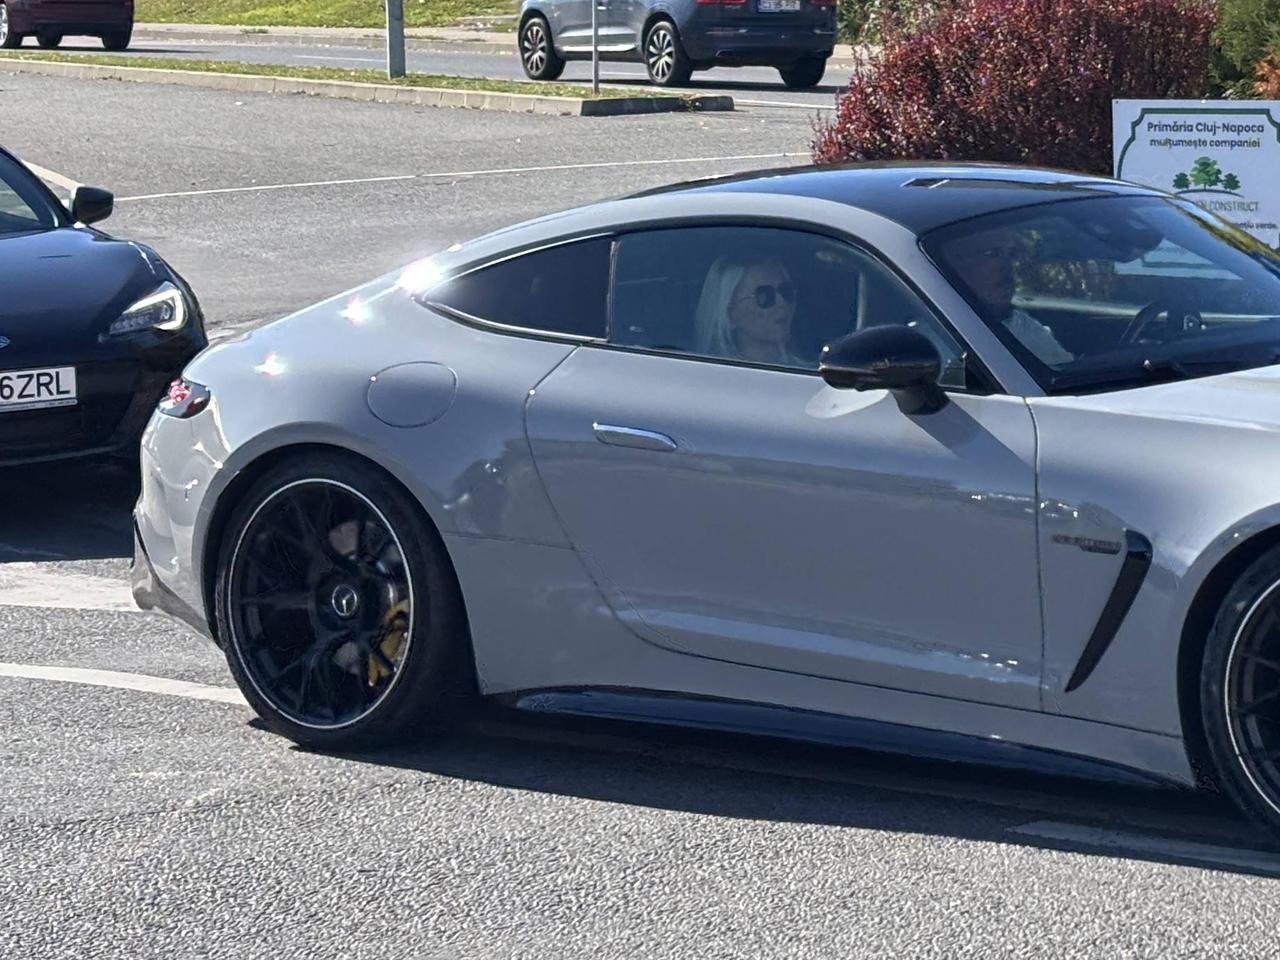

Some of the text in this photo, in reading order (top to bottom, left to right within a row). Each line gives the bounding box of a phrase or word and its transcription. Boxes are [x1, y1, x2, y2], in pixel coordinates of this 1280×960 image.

[1147, 121, 1265, 136] Primăria Cluj-Napoca
[1209, 137, 1261, 150] companiei
[1209, 201, 1260, 212] CONSTRUCT
